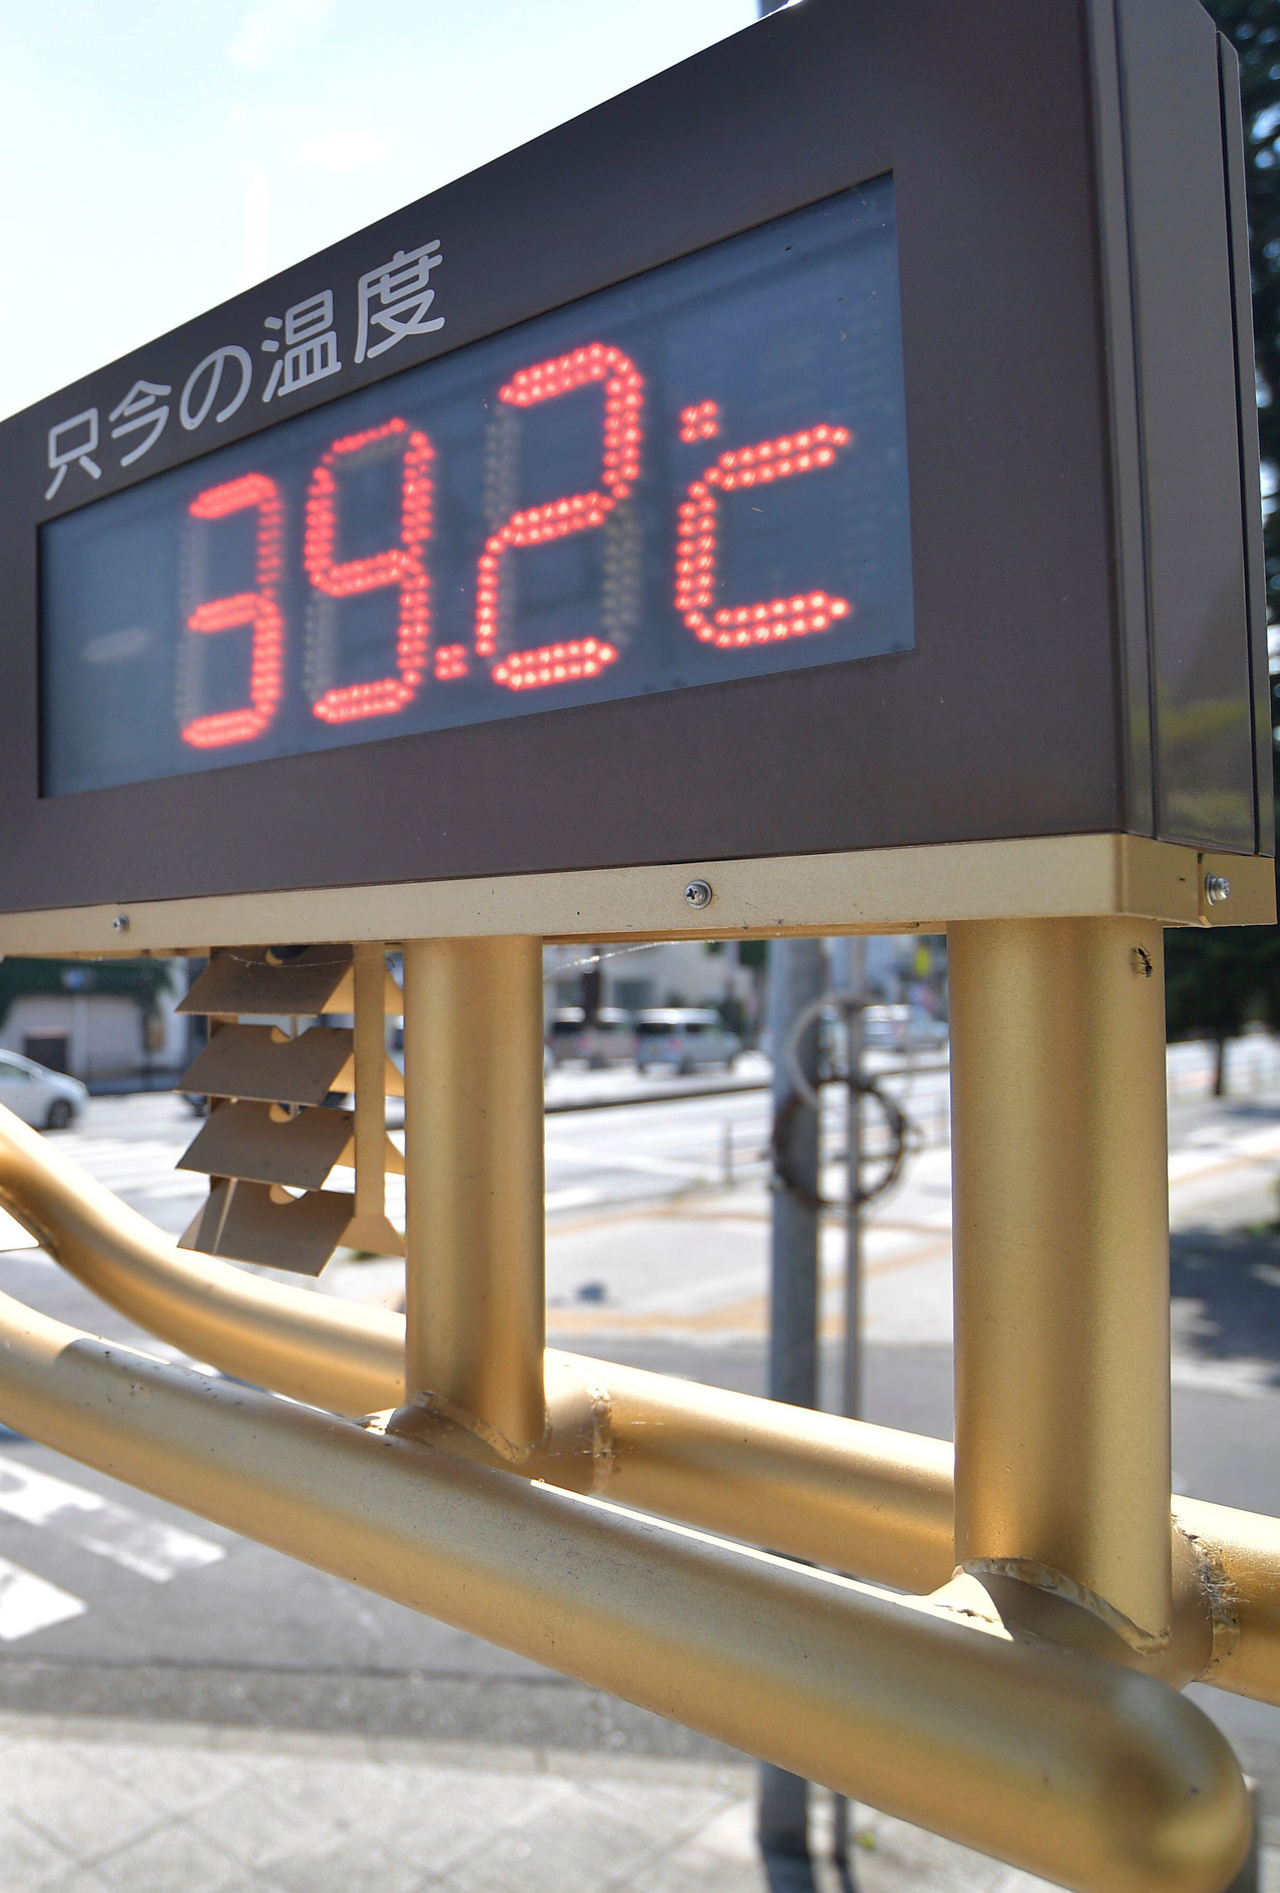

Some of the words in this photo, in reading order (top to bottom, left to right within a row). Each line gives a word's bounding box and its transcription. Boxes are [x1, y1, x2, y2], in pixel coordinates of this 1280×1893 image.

[45, 239, 446, 500] 只今の温度
